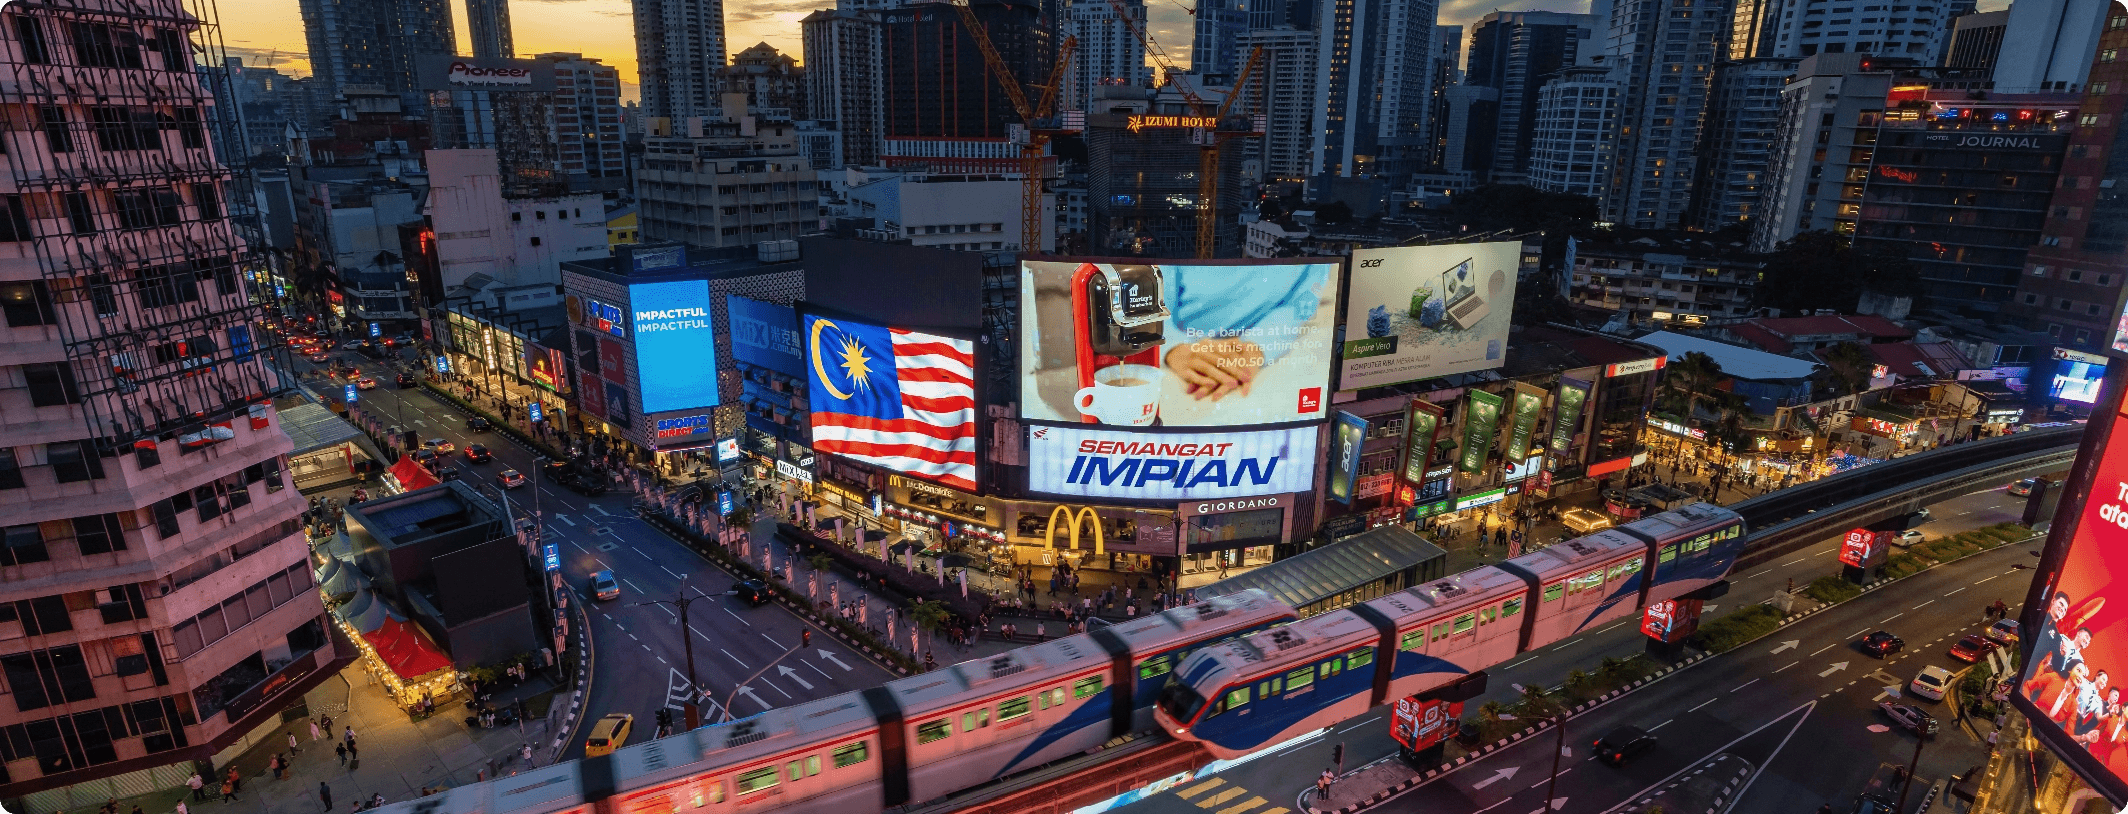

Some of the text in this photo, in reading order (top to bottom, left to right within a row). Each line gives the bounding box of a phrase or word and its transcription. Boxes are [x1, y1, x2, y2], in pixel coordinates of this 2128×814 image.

[449, 62, 530, 77] Pioneer
[1145, 117, 1177, 126] IZUMI
[1957, 136, 2040, 149] JOURNAL
[1361, 258, 1384, 268] acer
[636, 308, 708, 321] IMPACTFUL
[638, 320, 709, 333] IMPACTFUL
[1186, 328, 1204, 337] Be
[1220, 327, 1264, 337] barista
[1268, 326, 1280, 336] at
[1191, 343, 1214, 353] Get
[1218, 341, 1243, 352] this
[1246, 340, 1300, 351] machine
[1352, 341, 1391, 355] Aspire Vero
[1216, 356, 1264, 368] RM0.50
[1350, 361, 1382, 371] KOMPUTER
[657, 414, 710, 430] SPORTS
[1078, 440, 1234, 457] SEMANGAT
[1342, 435, 1352, 472] acer
[1066, 455, 1280, 489] IMPIAN
[907, 480, 953, 498] McDonald's
[1198, 498, 1277, 514] GIORDANO
